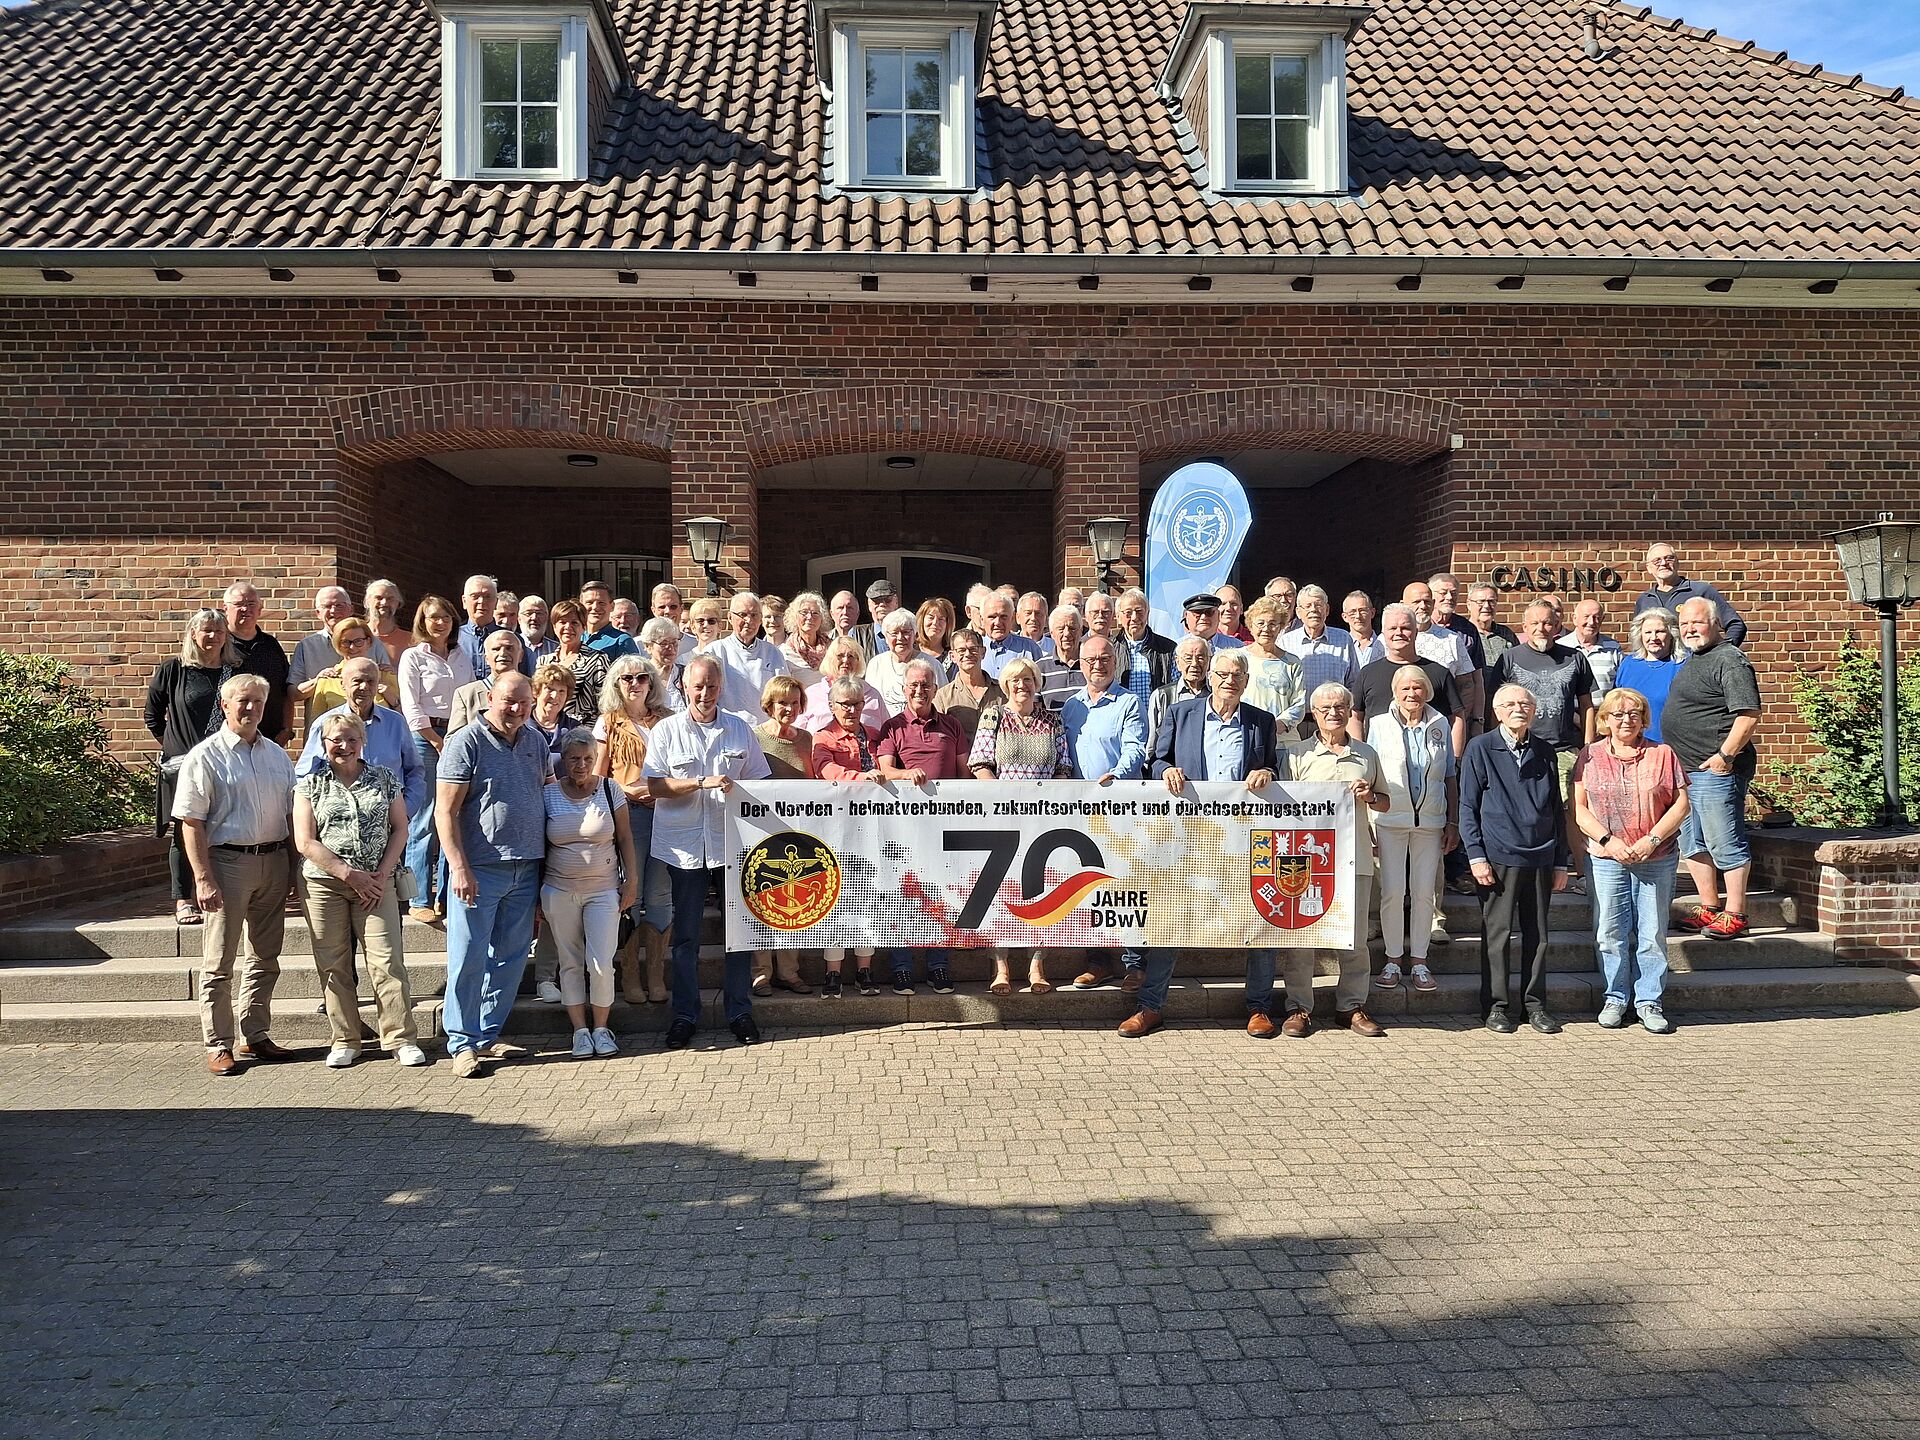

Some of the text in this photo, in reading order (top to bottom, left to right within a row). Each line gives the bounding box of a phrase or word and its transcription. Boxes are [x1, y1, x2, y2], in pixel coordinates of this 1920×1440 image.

[1491, 566, 1620, 591] CASINO
[740, 801, 770, 818] Der
[775, 800, 833, 817] Norden
[849, 799, 987, 818] heimatverbunden,
[993, 799, 1137, 816] zukunftsorientiert
[1142, 800, 1170, 816] und
[1175, 799, 1336, 818] durchsetzungsstark
[942, 828, 1106, 930] 70
[1092, 890, 1148, 907] JAHRE
[1091, 909, 1148, 928] DBwV
